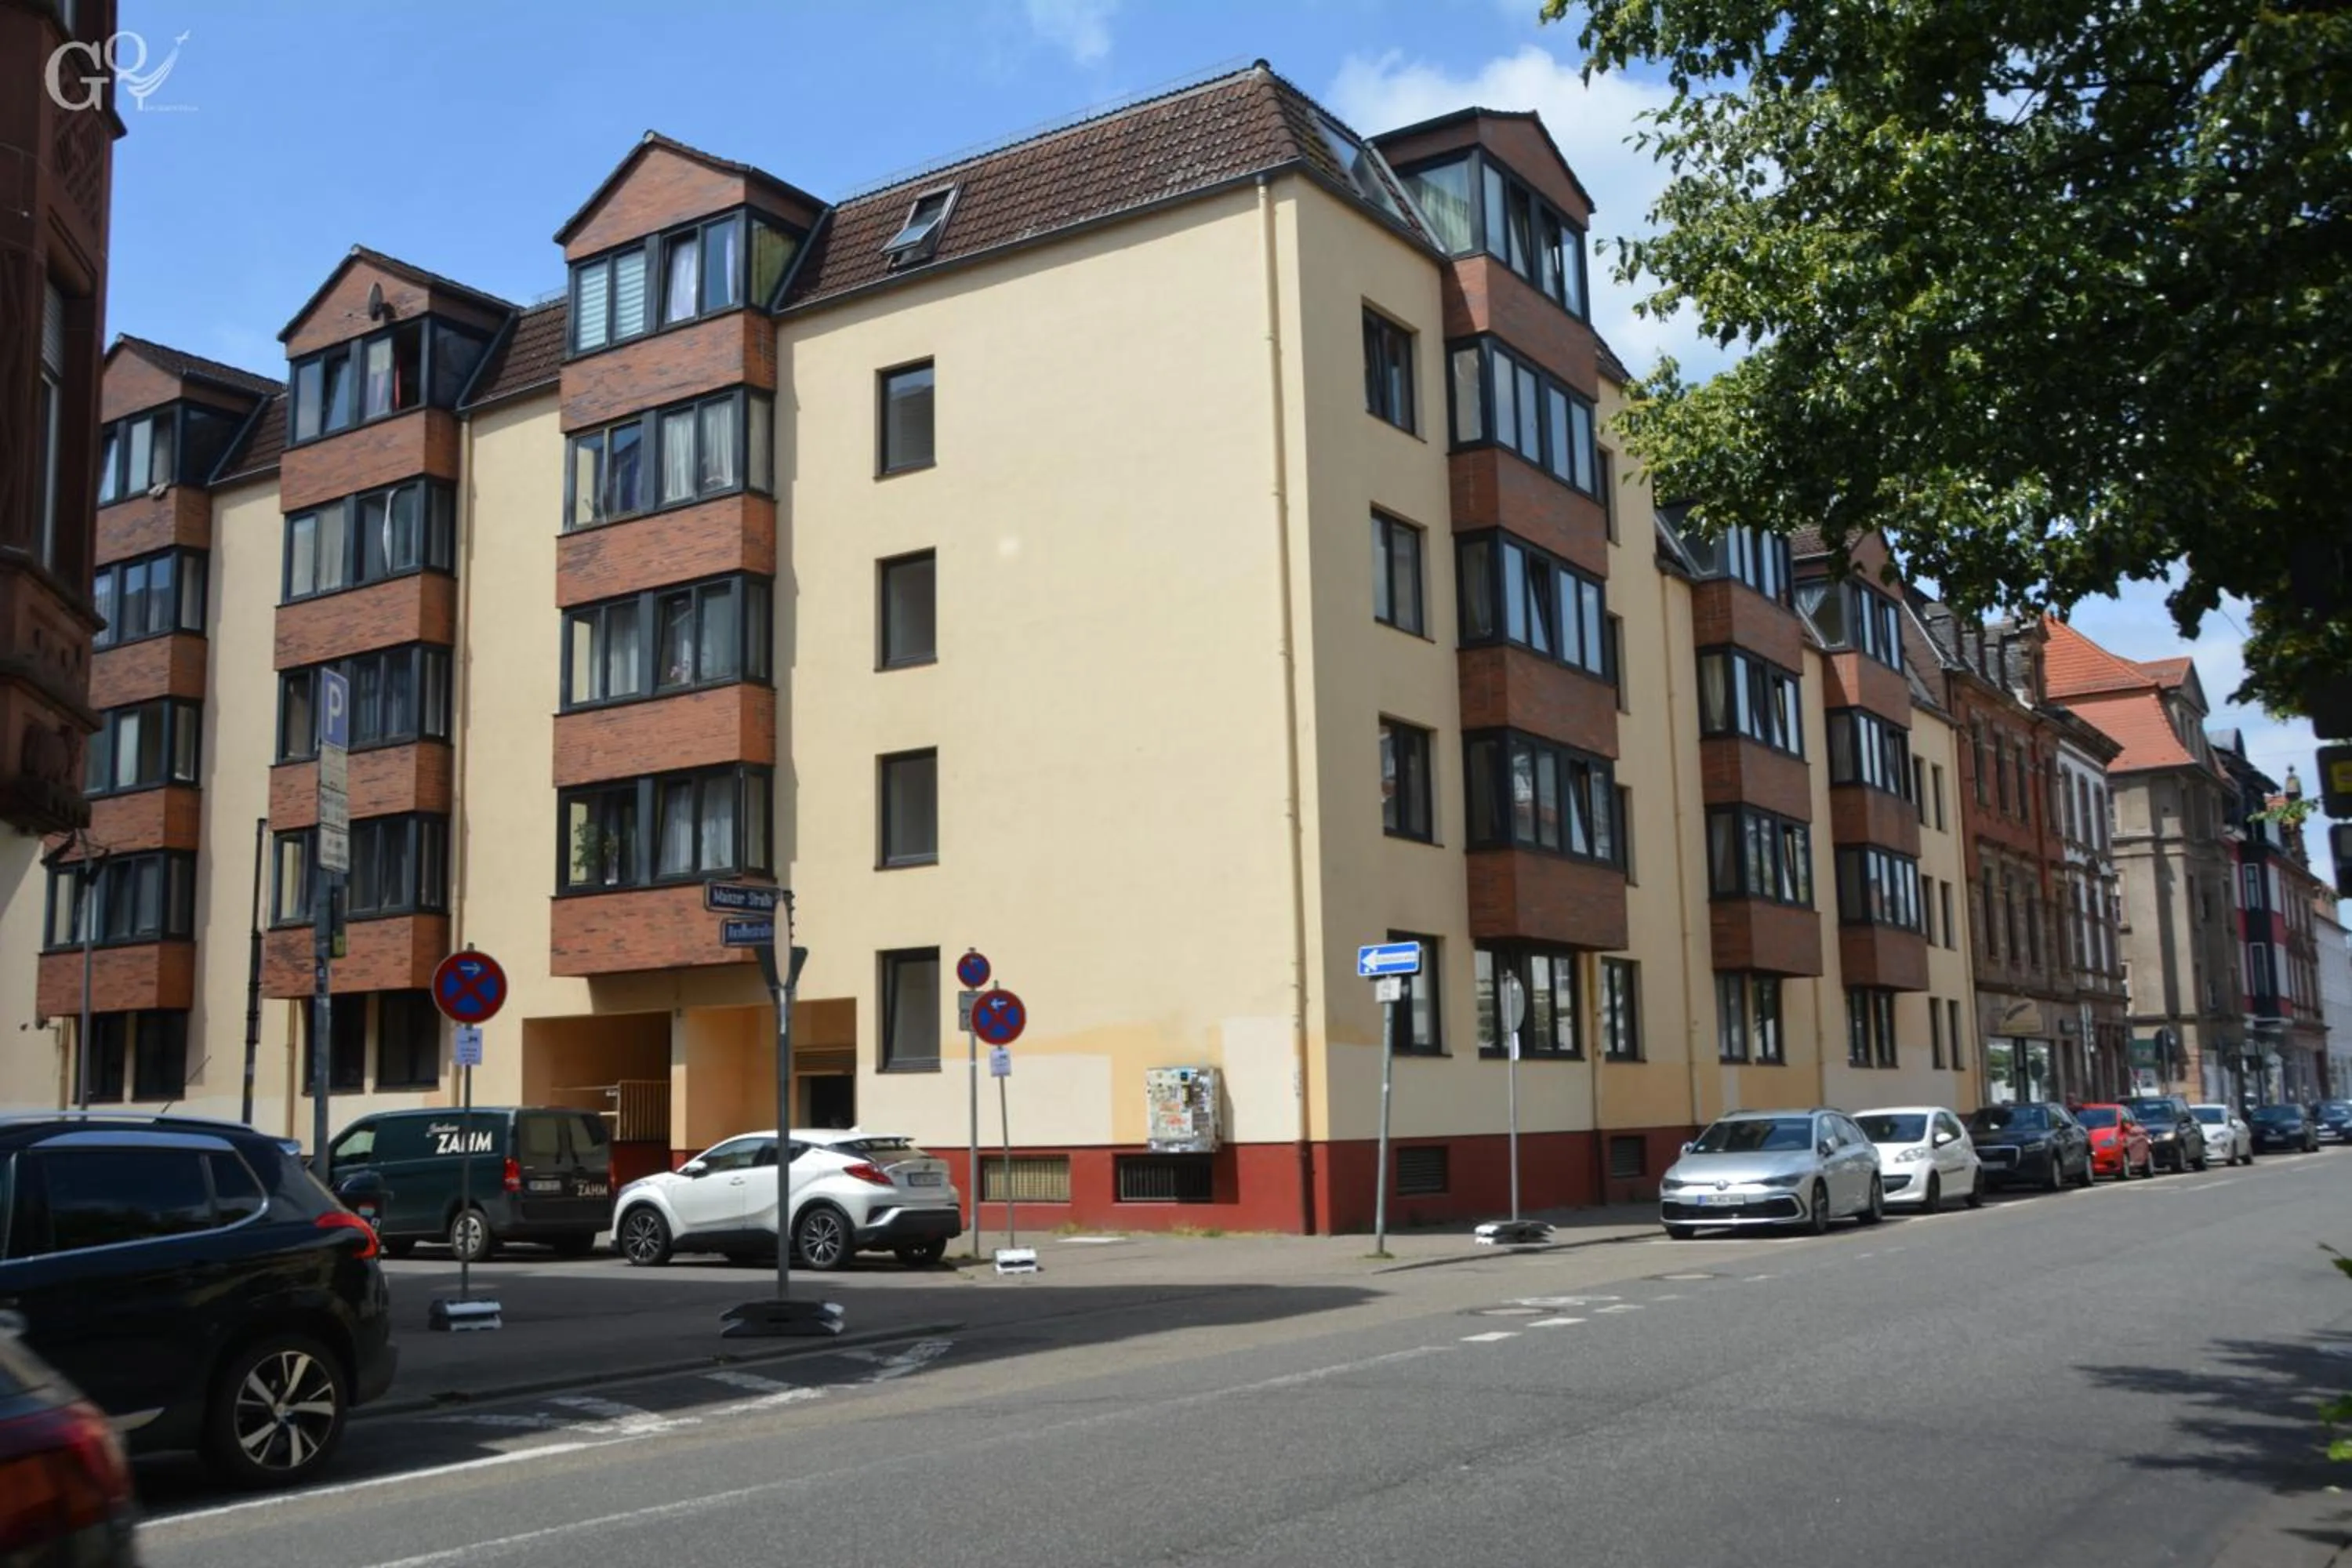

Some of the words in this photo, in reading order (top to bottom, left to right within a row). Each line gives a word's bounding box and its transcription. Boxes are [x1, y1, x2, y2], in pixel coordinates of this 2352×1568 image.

[328, 682, 343, 735] P
[436, 1131, 492, 1154] ZAHM
[577, 1183, 608, 1196] ZAHM
